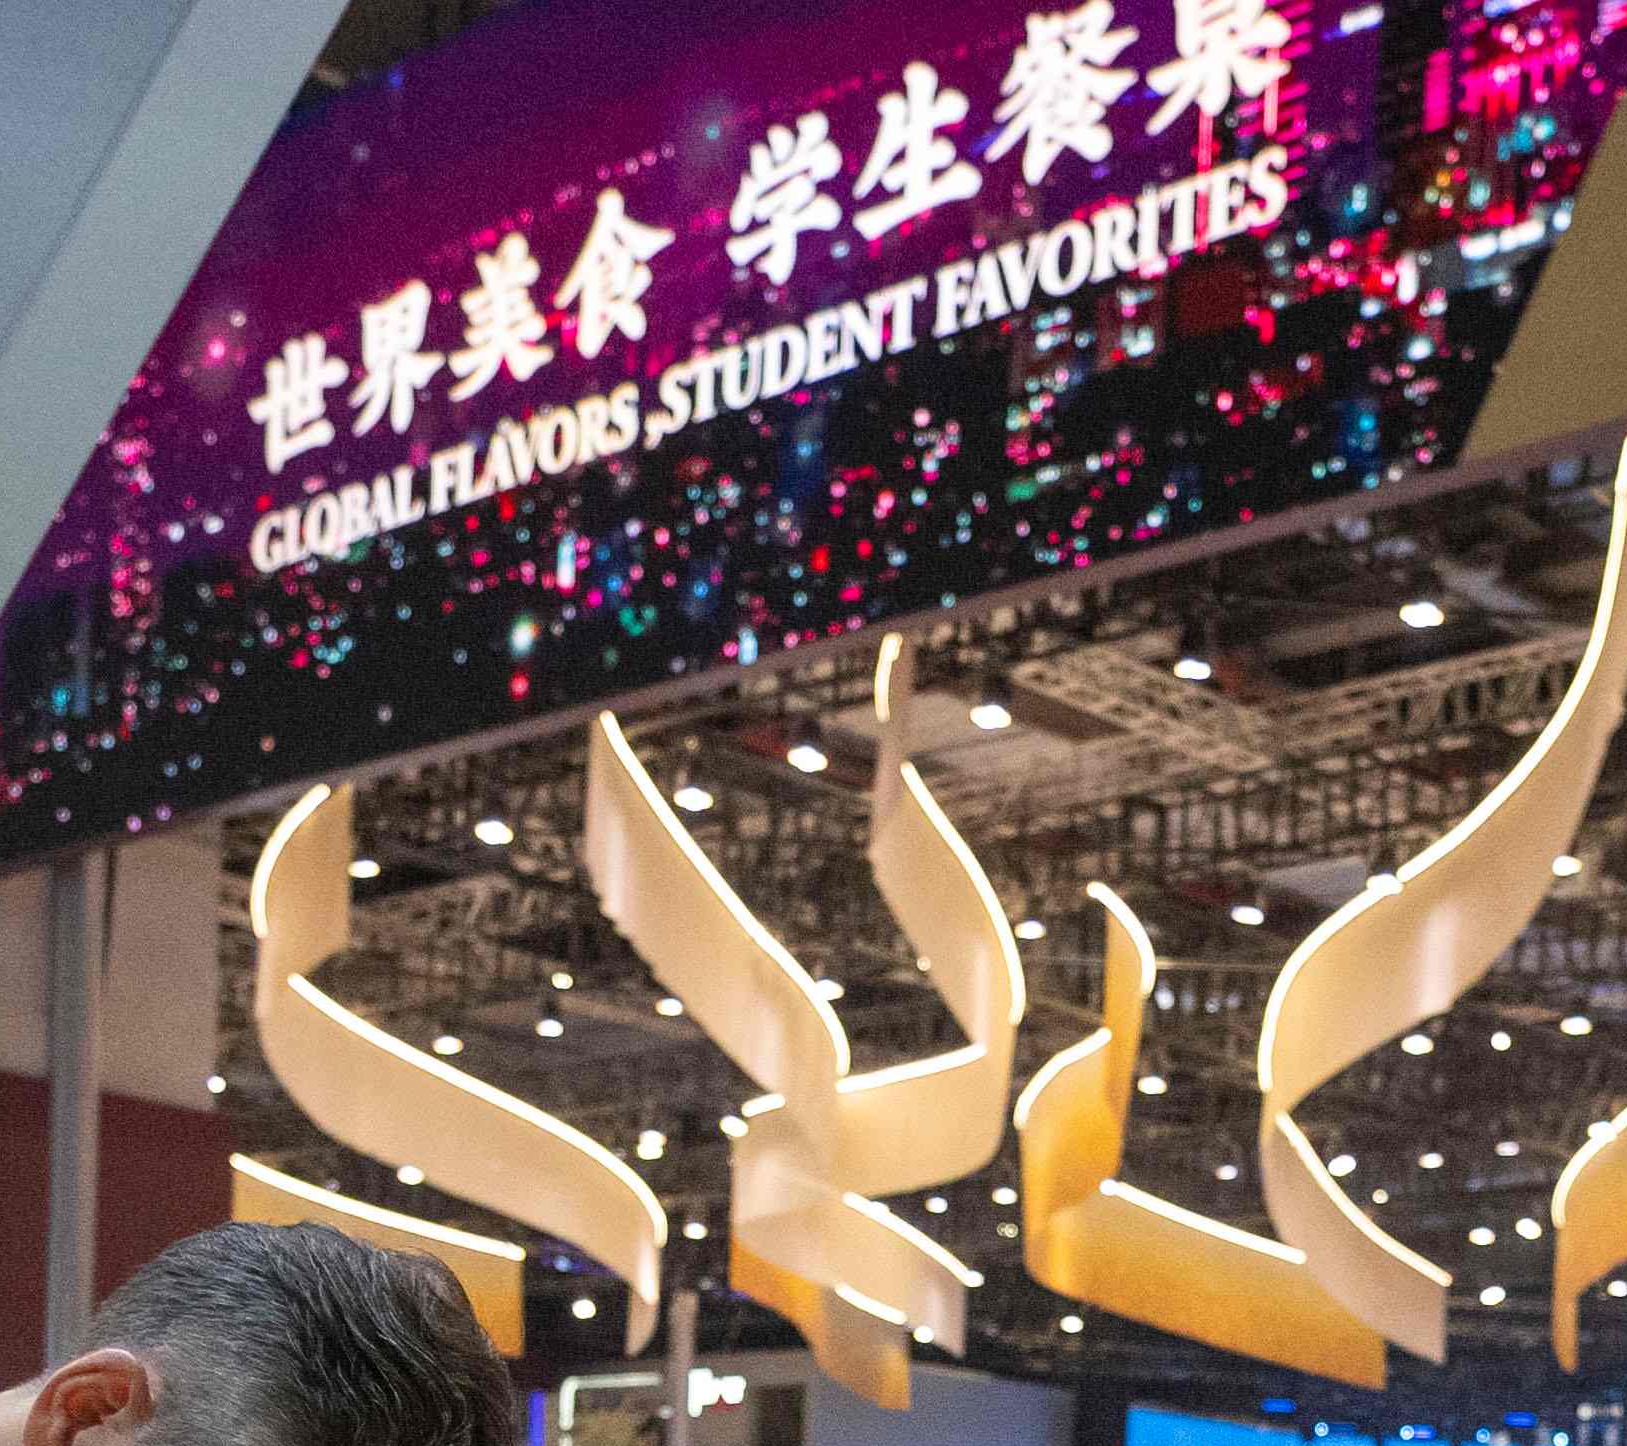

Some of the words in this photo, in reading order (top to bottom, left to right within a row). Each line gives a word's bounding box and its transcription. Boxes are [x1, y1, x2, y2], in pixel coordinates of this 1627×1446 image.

[247, 187, 676, 474] 世界美食
[249, 465, 425, 575] GLOBAL
[428, 381, 640, 515] FLAVORS
[931, 146, 1289, 338] FAVORITES
